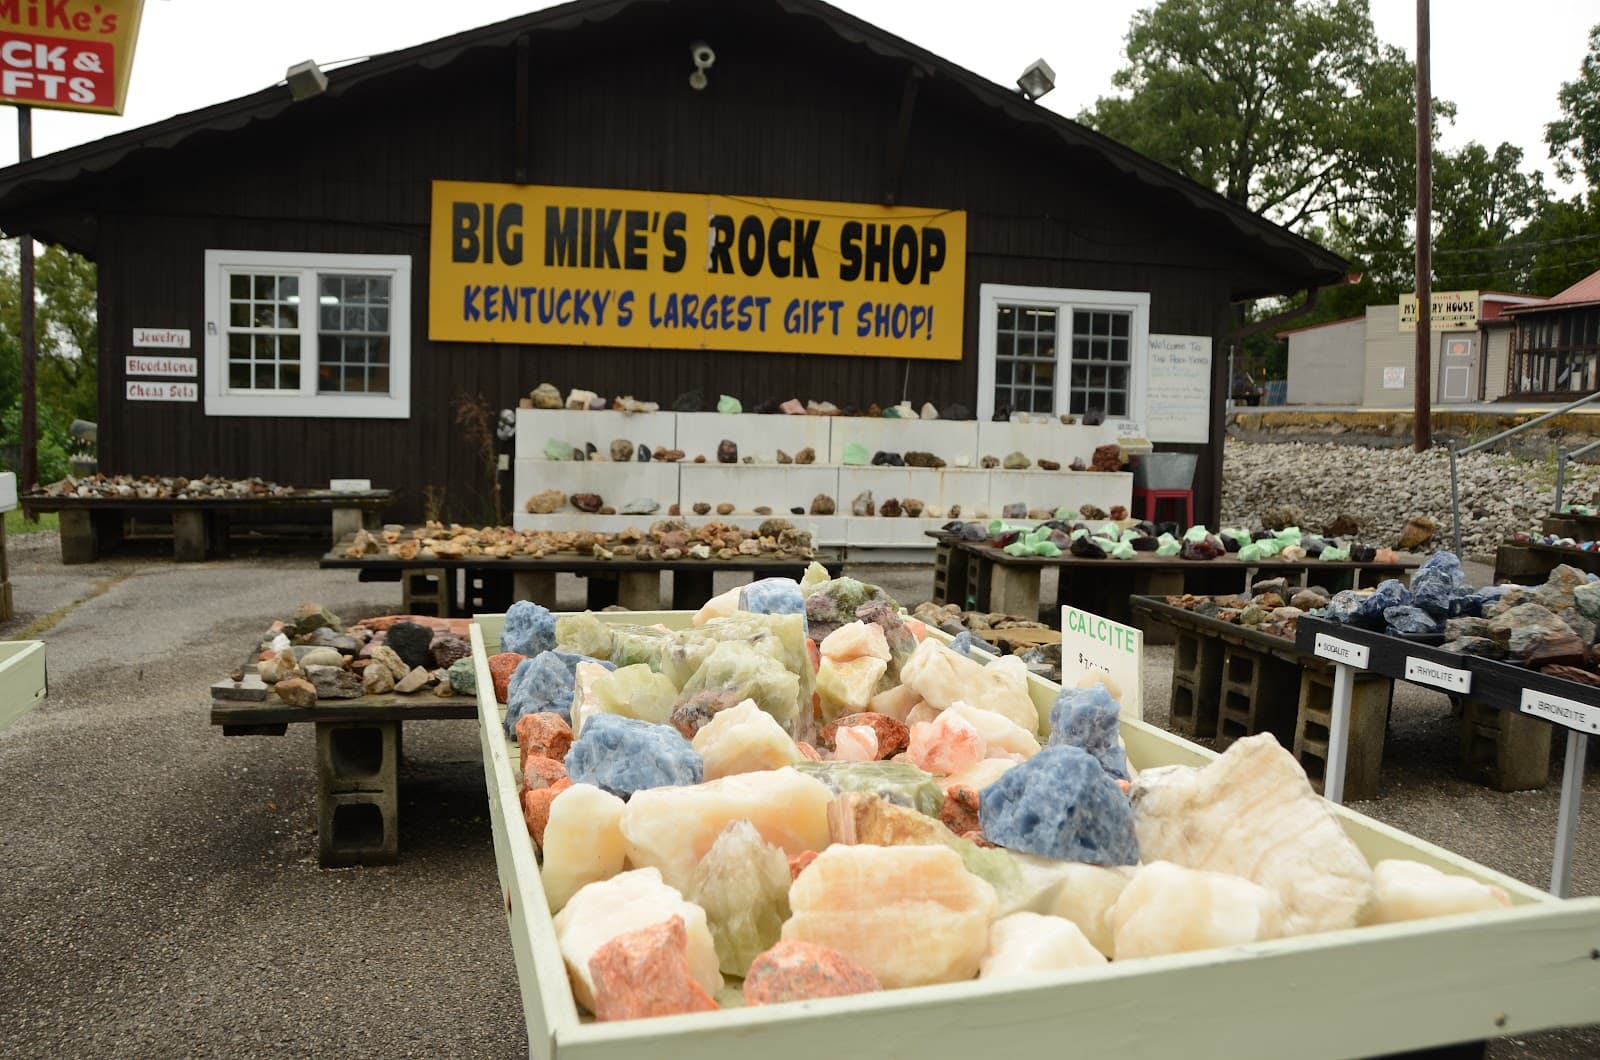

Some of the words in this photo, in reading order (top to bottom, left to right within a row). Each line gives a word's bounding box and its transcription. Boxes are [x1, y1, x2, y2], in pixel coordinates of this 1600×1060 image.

[0, 40, 66, 72] CK
[73, 52, 104, 73] &
[452, 201, 523, 266] BIG
[544, 205, 687, 273] MIKE'S
[708, 214, 821, 279] ROCK
[840, 221, 946, 285] SHOP
[463, 284, 635, 328] KENTUCKY'S
[649, 292, 771, 333] LARGEST
[784, 298, 844, 336] GIFT
[857, 302, 934, 340] SHOP!
[1404, 303, 1443, 314] MYRY
[1446, 301, 1474, 313] HOUSE
[138, 331, 184, 345] Jewelry
[129, 359, 194, 373] Bloodstone
[129, 384, 163, 397] Chess
[170, 385, 194, 397] Sets
[1069, 610, 1134, 653] CALCITE
[1323, 642, 1351, 658] SODALITE
[1417, 665, 1453, 682] RHYOLITE
[1538, 700, 1585, 723] BRONZITE
